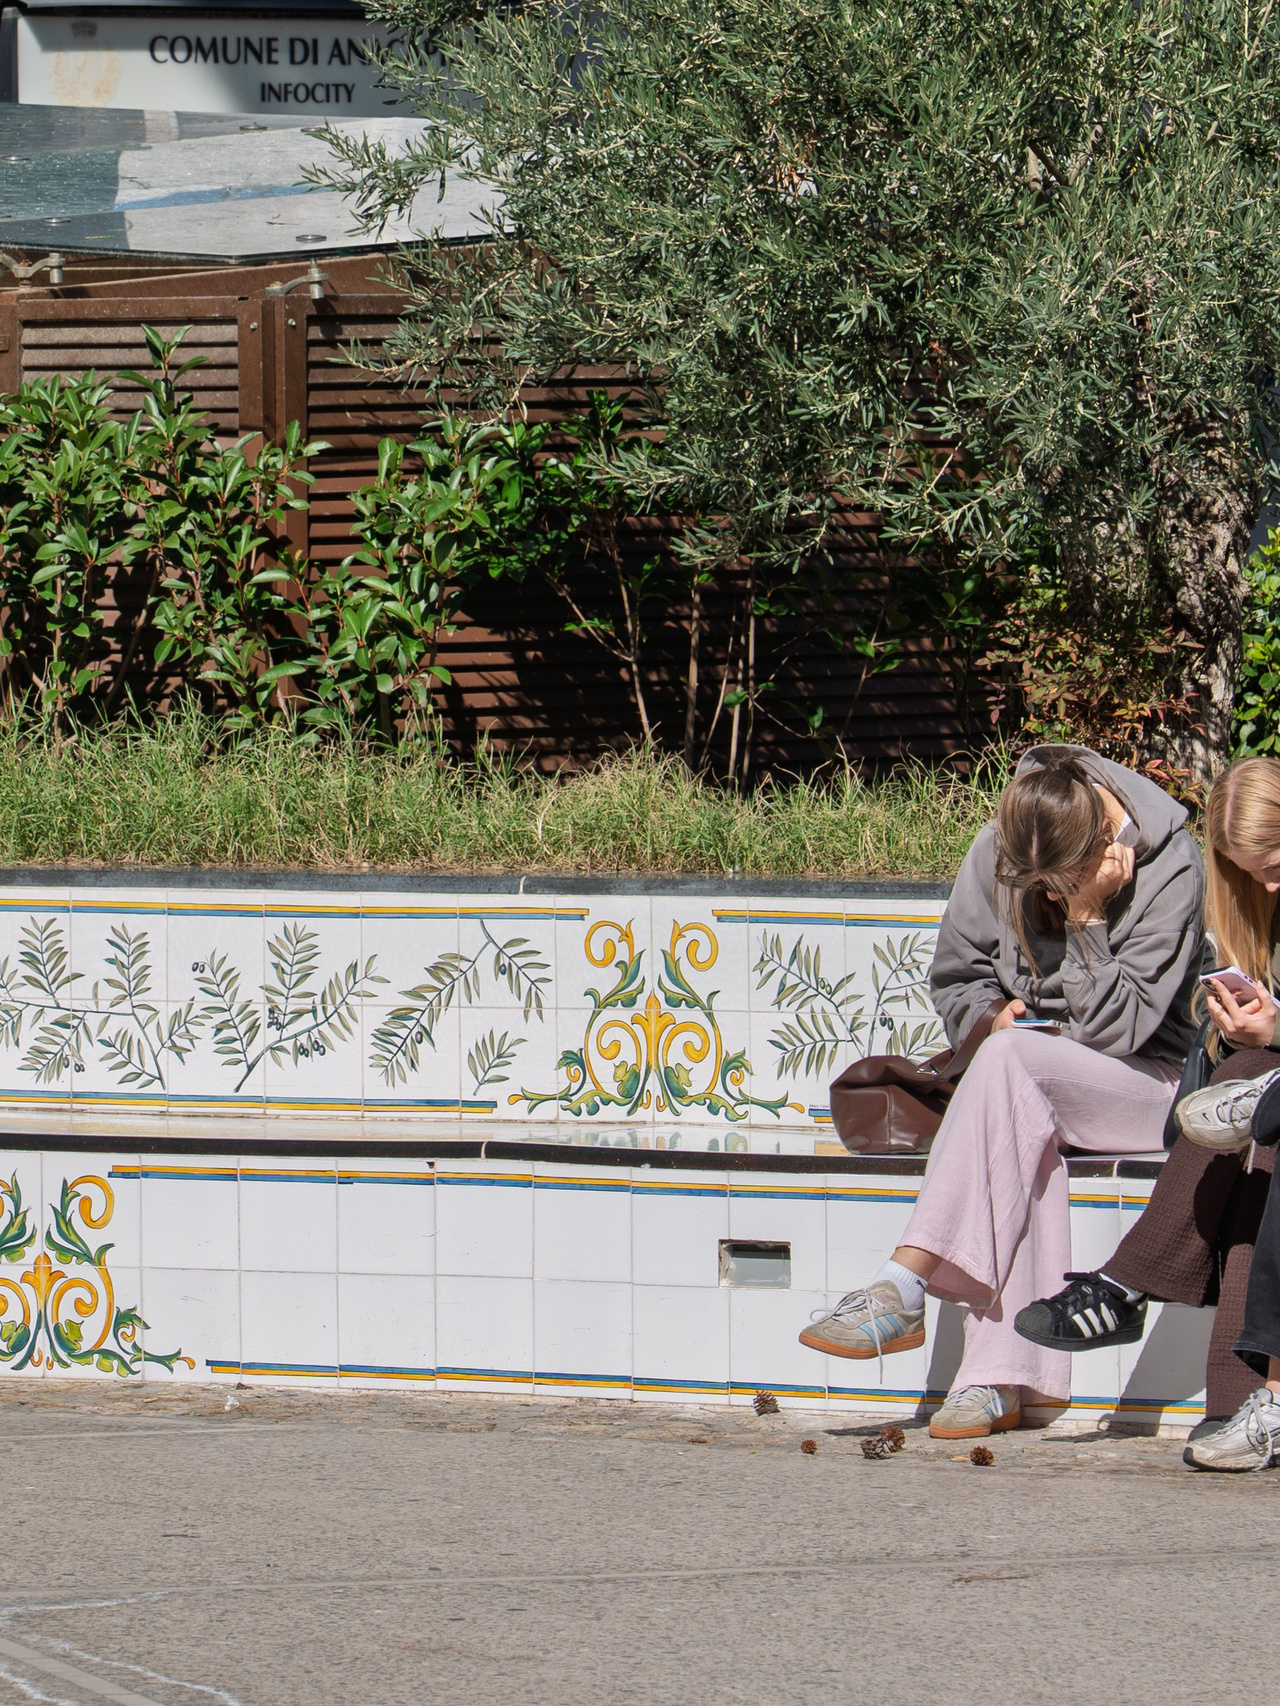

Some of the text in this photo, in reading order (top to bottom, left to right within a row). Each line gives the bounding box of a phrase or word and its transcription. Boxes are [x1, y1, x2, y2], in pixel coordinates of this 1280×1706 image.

[149, 35, 464, 66] COMUNE DI ANACP
[260, 82, 356, 104] INFOCITY
